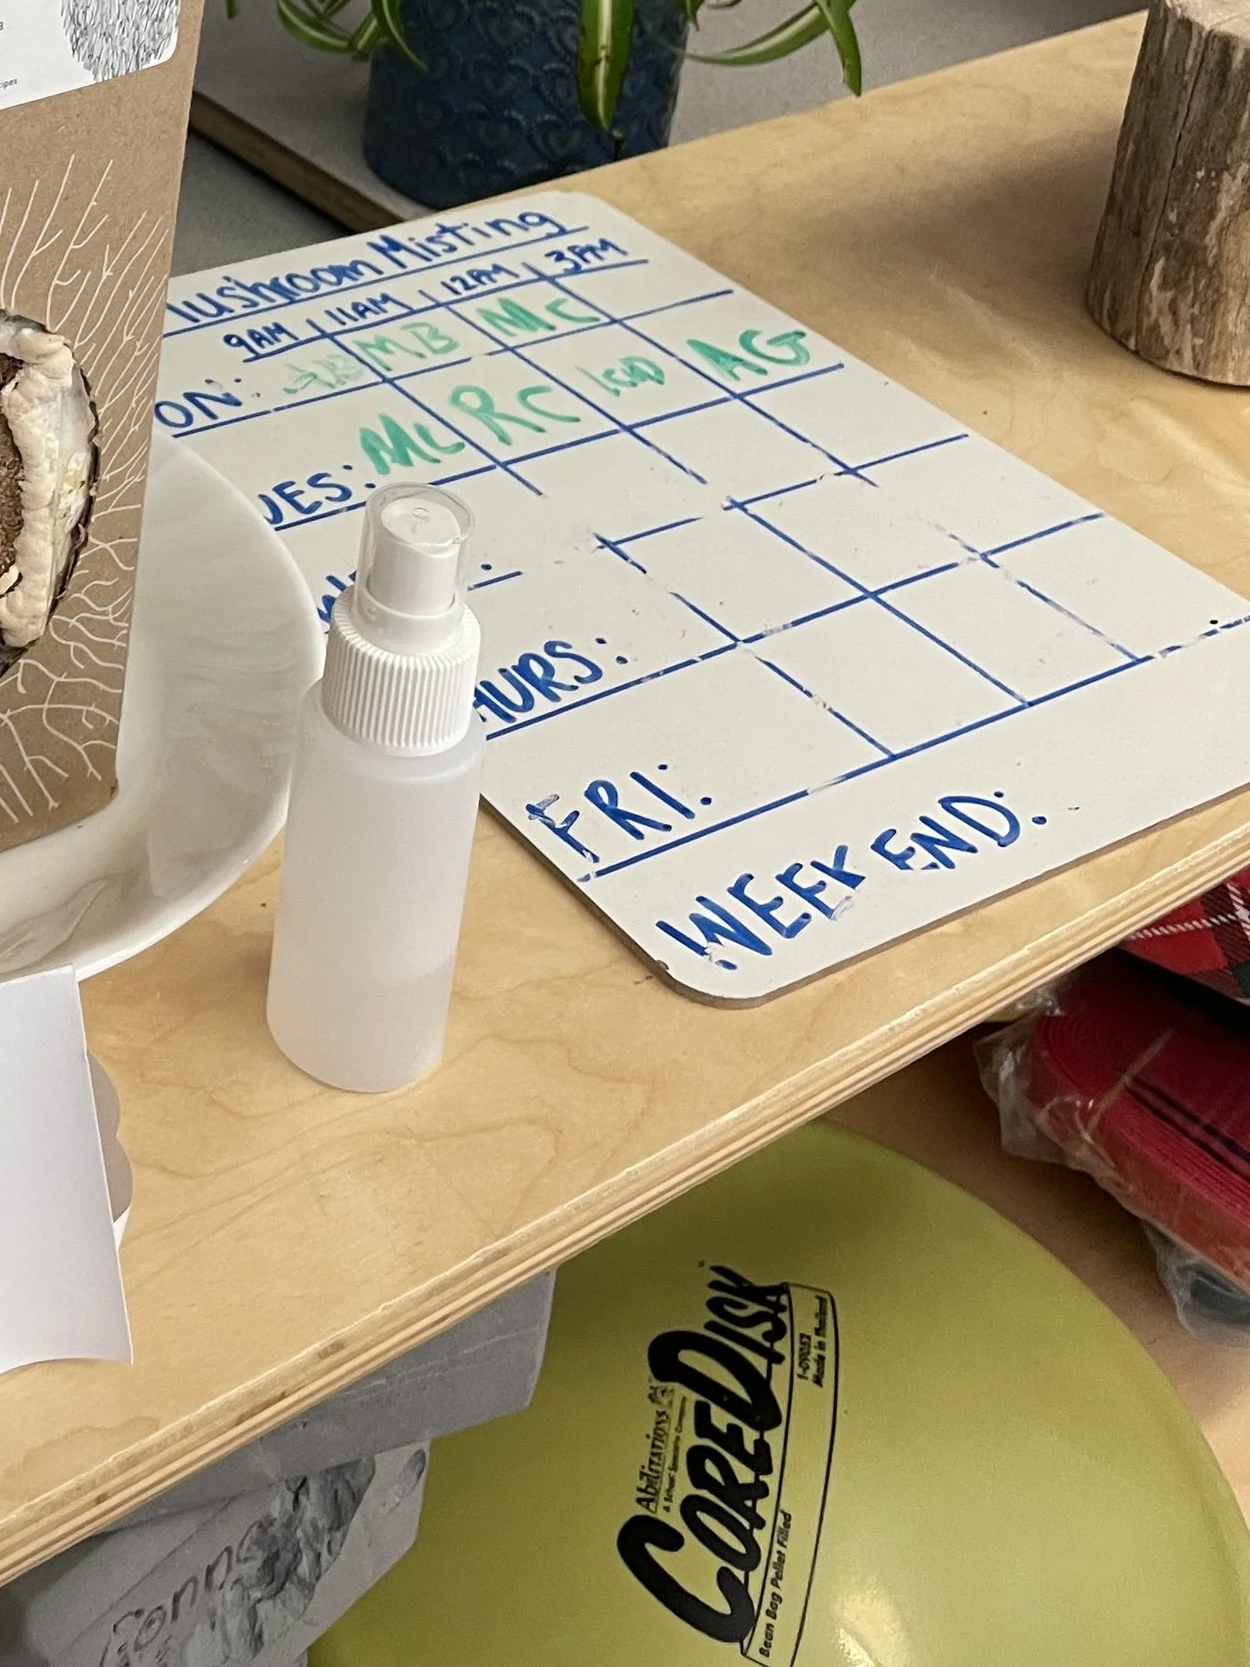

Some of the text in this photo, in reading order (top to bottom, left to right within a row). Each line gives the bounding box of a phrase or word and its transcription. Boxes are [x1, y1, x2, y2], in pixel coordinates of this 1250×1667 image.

[366, 210, 570, 270] Misting
[223, 321, 299, 364] 9AM
[325, 292, 414, 326] 11AM
[154, 377, 262, 429] ON:
[258, 464, 377, 525] UES:
[686, 328, 812, 382] AG
[474, 638, 629, 724] HURS:
[525, 764, 713, 864] FRI:
[759, 1509, 792, 1658] Bean Bag Pellet Filled
